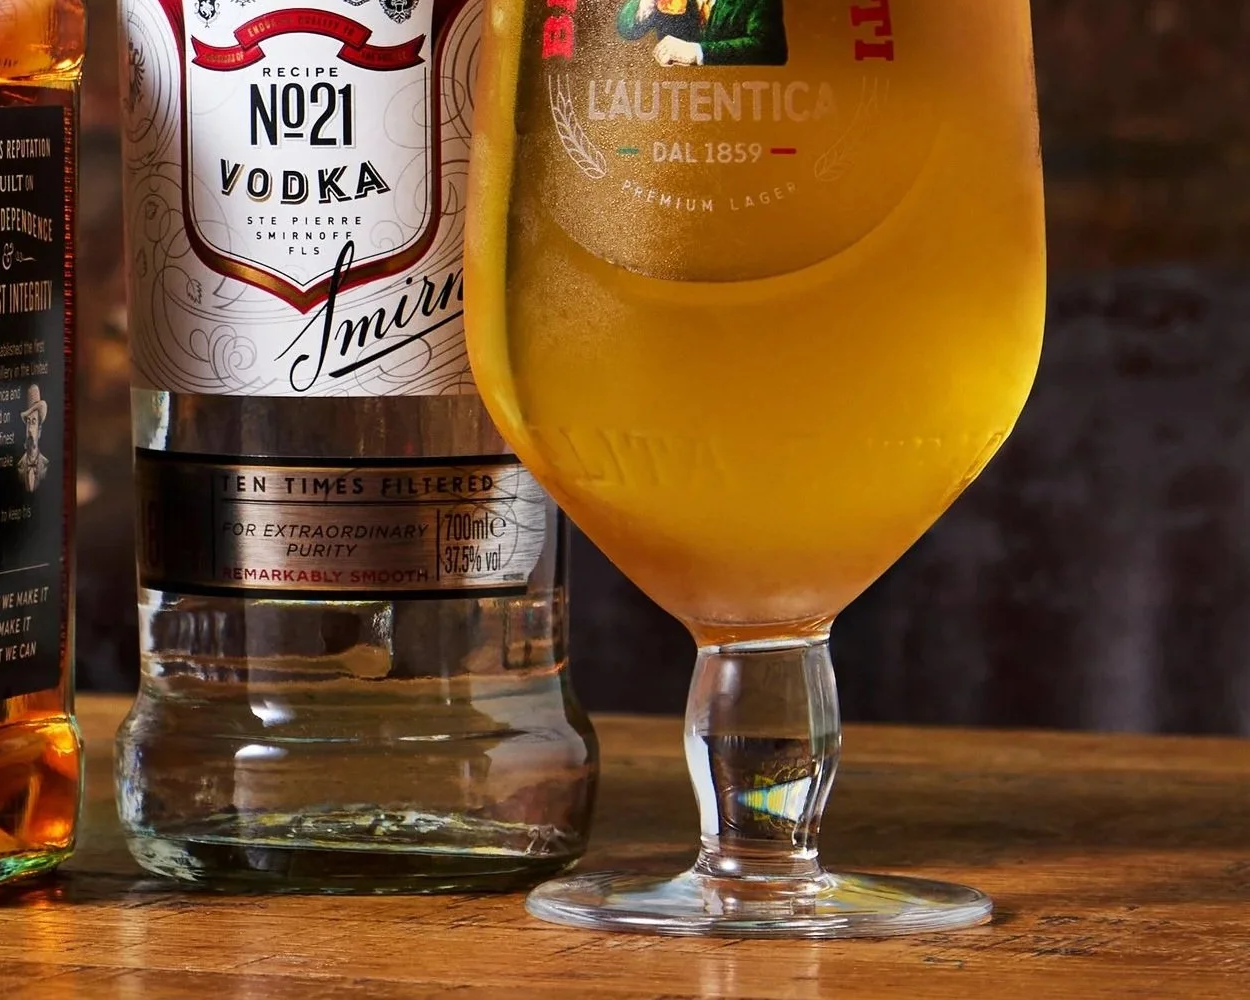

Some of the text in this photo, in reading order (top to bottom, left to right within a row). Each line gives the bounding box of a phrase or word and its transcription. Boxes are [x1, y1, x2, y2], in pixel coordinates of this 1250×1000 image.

[262, 67, 339, 78] RECIPE
[587, 79, 840, 122] L'AUTENTICA
[6, 138, 50, 159] REPUTATION
[652, 142, 762, 163] DAL 1859
[25, 175, 34, 191] ON
[220, 159, 391, 205] VODKA
[621, 179, 797, 212] PREMIUM LAGER
[247, 216, 362, 226] STE PIERRE
[256, 231, 353, 241] SMIRNOFF
[289, 246, 321, 256] FLS
[9, 280, 53, 313] INTEGRITY
[274, 240, 464, 392] Smirn
[222, 475, 494, 494] TEN TIMES FILTERED
[222, 522, 429, 540] FOR EXTRAORDINARY
[445, 512, 488, 540] 700ml
[286, 543, 358, 558] PURITY
[445, 543, 501, 573] 37.5% vol
[222, 567, 429, 583] REMARKABLY SMOOTH
[2, 592, 14, 609] WE
[16, 588, 39, 607] MAKE
[40, 586, 49, 602] IT
[22, 616, 32, 632] IT
[5, 645, 18, 661] WE
[19, 641, 37, 659] CAN
